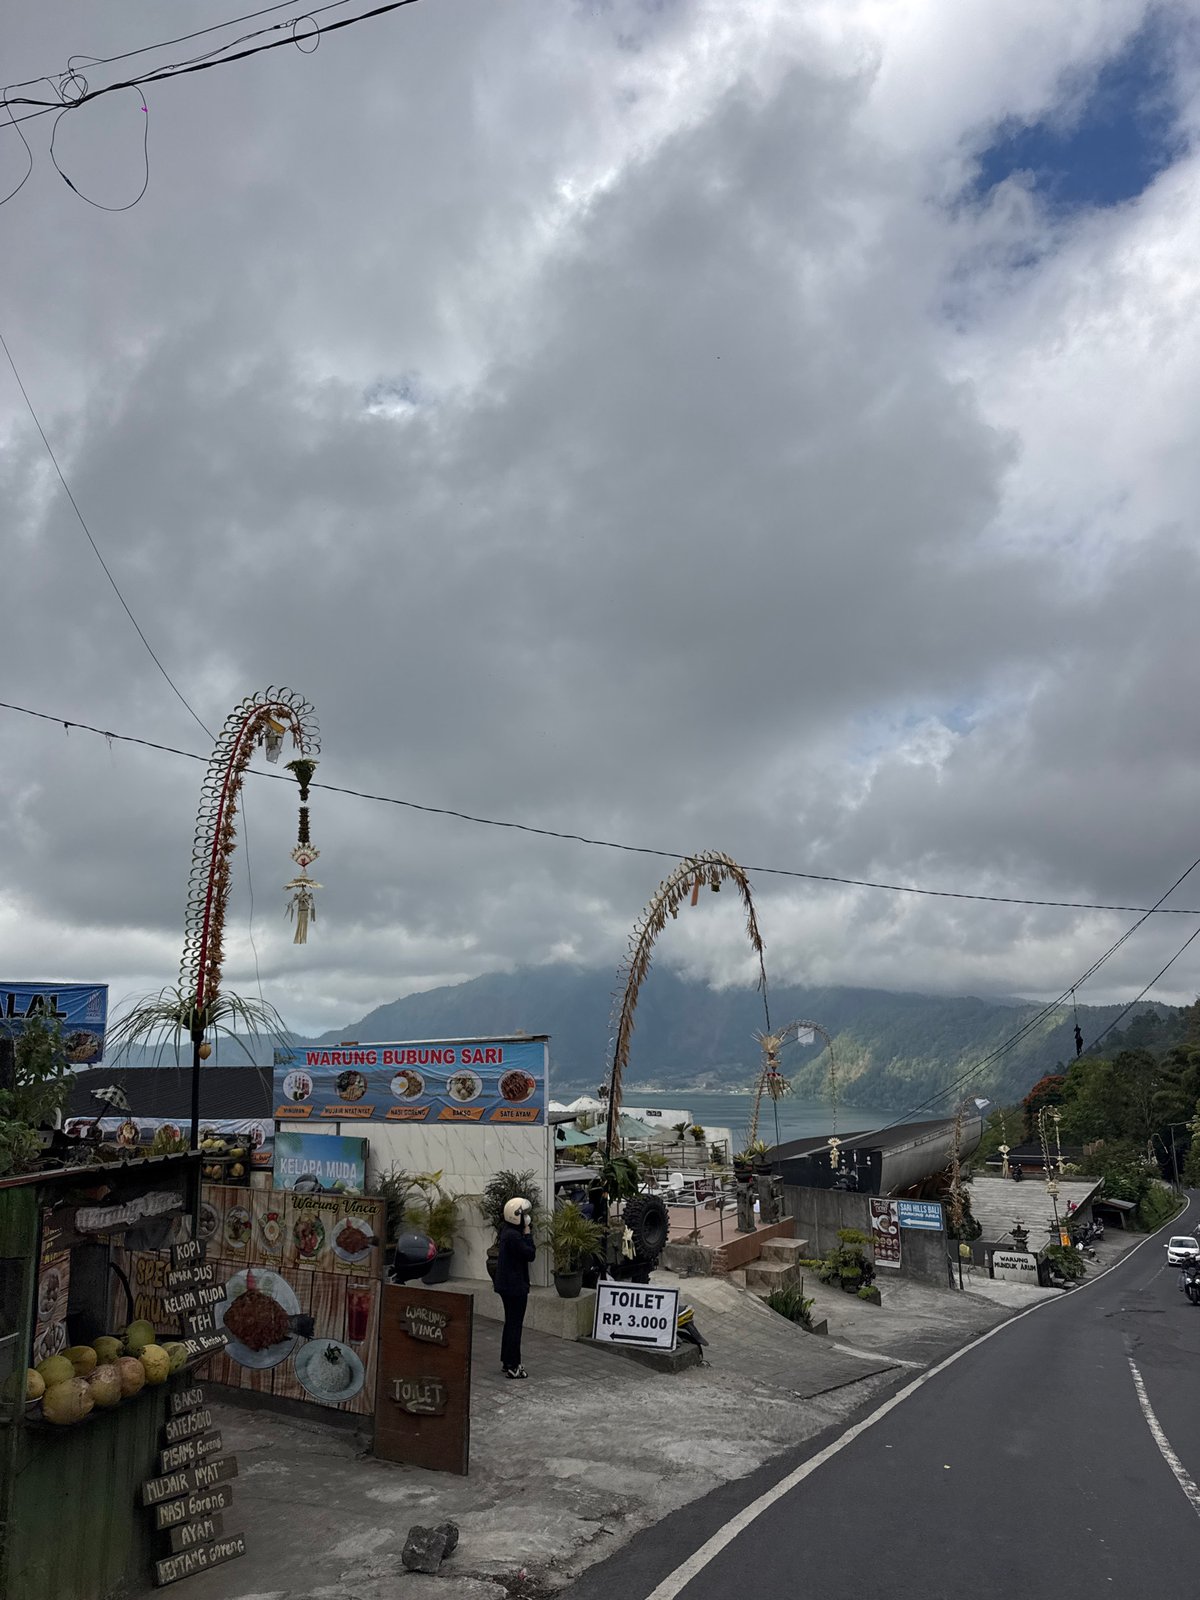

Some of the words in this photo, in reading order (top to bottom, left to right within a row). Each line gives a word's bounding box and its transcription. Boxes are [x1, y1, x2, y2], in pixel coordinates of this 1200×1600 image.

[0, 994, 67, 1018] LAL
[306, 1051, 377, 1065] WARUNG
[383, 1050, 455, 1064] BUBUNG
[461, 1049, 503, 1063] SARI
[280, 1158, 323, 1176] KELAPA
[326, 1161, 357, 1178] MUDA
[291, 1195, 339, 1214] Warung
[342, 1199, 380, 1214] Vinca
[176, 1240, 201, 1260] KOPI
[1000, 1256, 1029, 1264] WARUNG
[193, 1264, 212, 1281] JUS
[163, 1292, 197, 1314] KELAPA
[198, 1286, 225, 1304] MUDA
[610, 1291, 665, 1310] TOILET
[189, 1313, 212, 1334] TEH
[405, 1305, 447, 1327] WARUNG
[602, 1312, 623, 1326] RP.
[627, 1314, 668, 1330] 3.000
[411, 1322, 443, 1341] VINCA
[174, 1389, 203, 1411] BAKSO
[393, 1378, 443, 1404] TOILET
[163, 1442, 195, 1471] PISANG
[159, 1502, 186, 1525] NASI
[181, 1520, 214, 1545] AYAM
[159, 1548, 206, 1583] KENTANG
